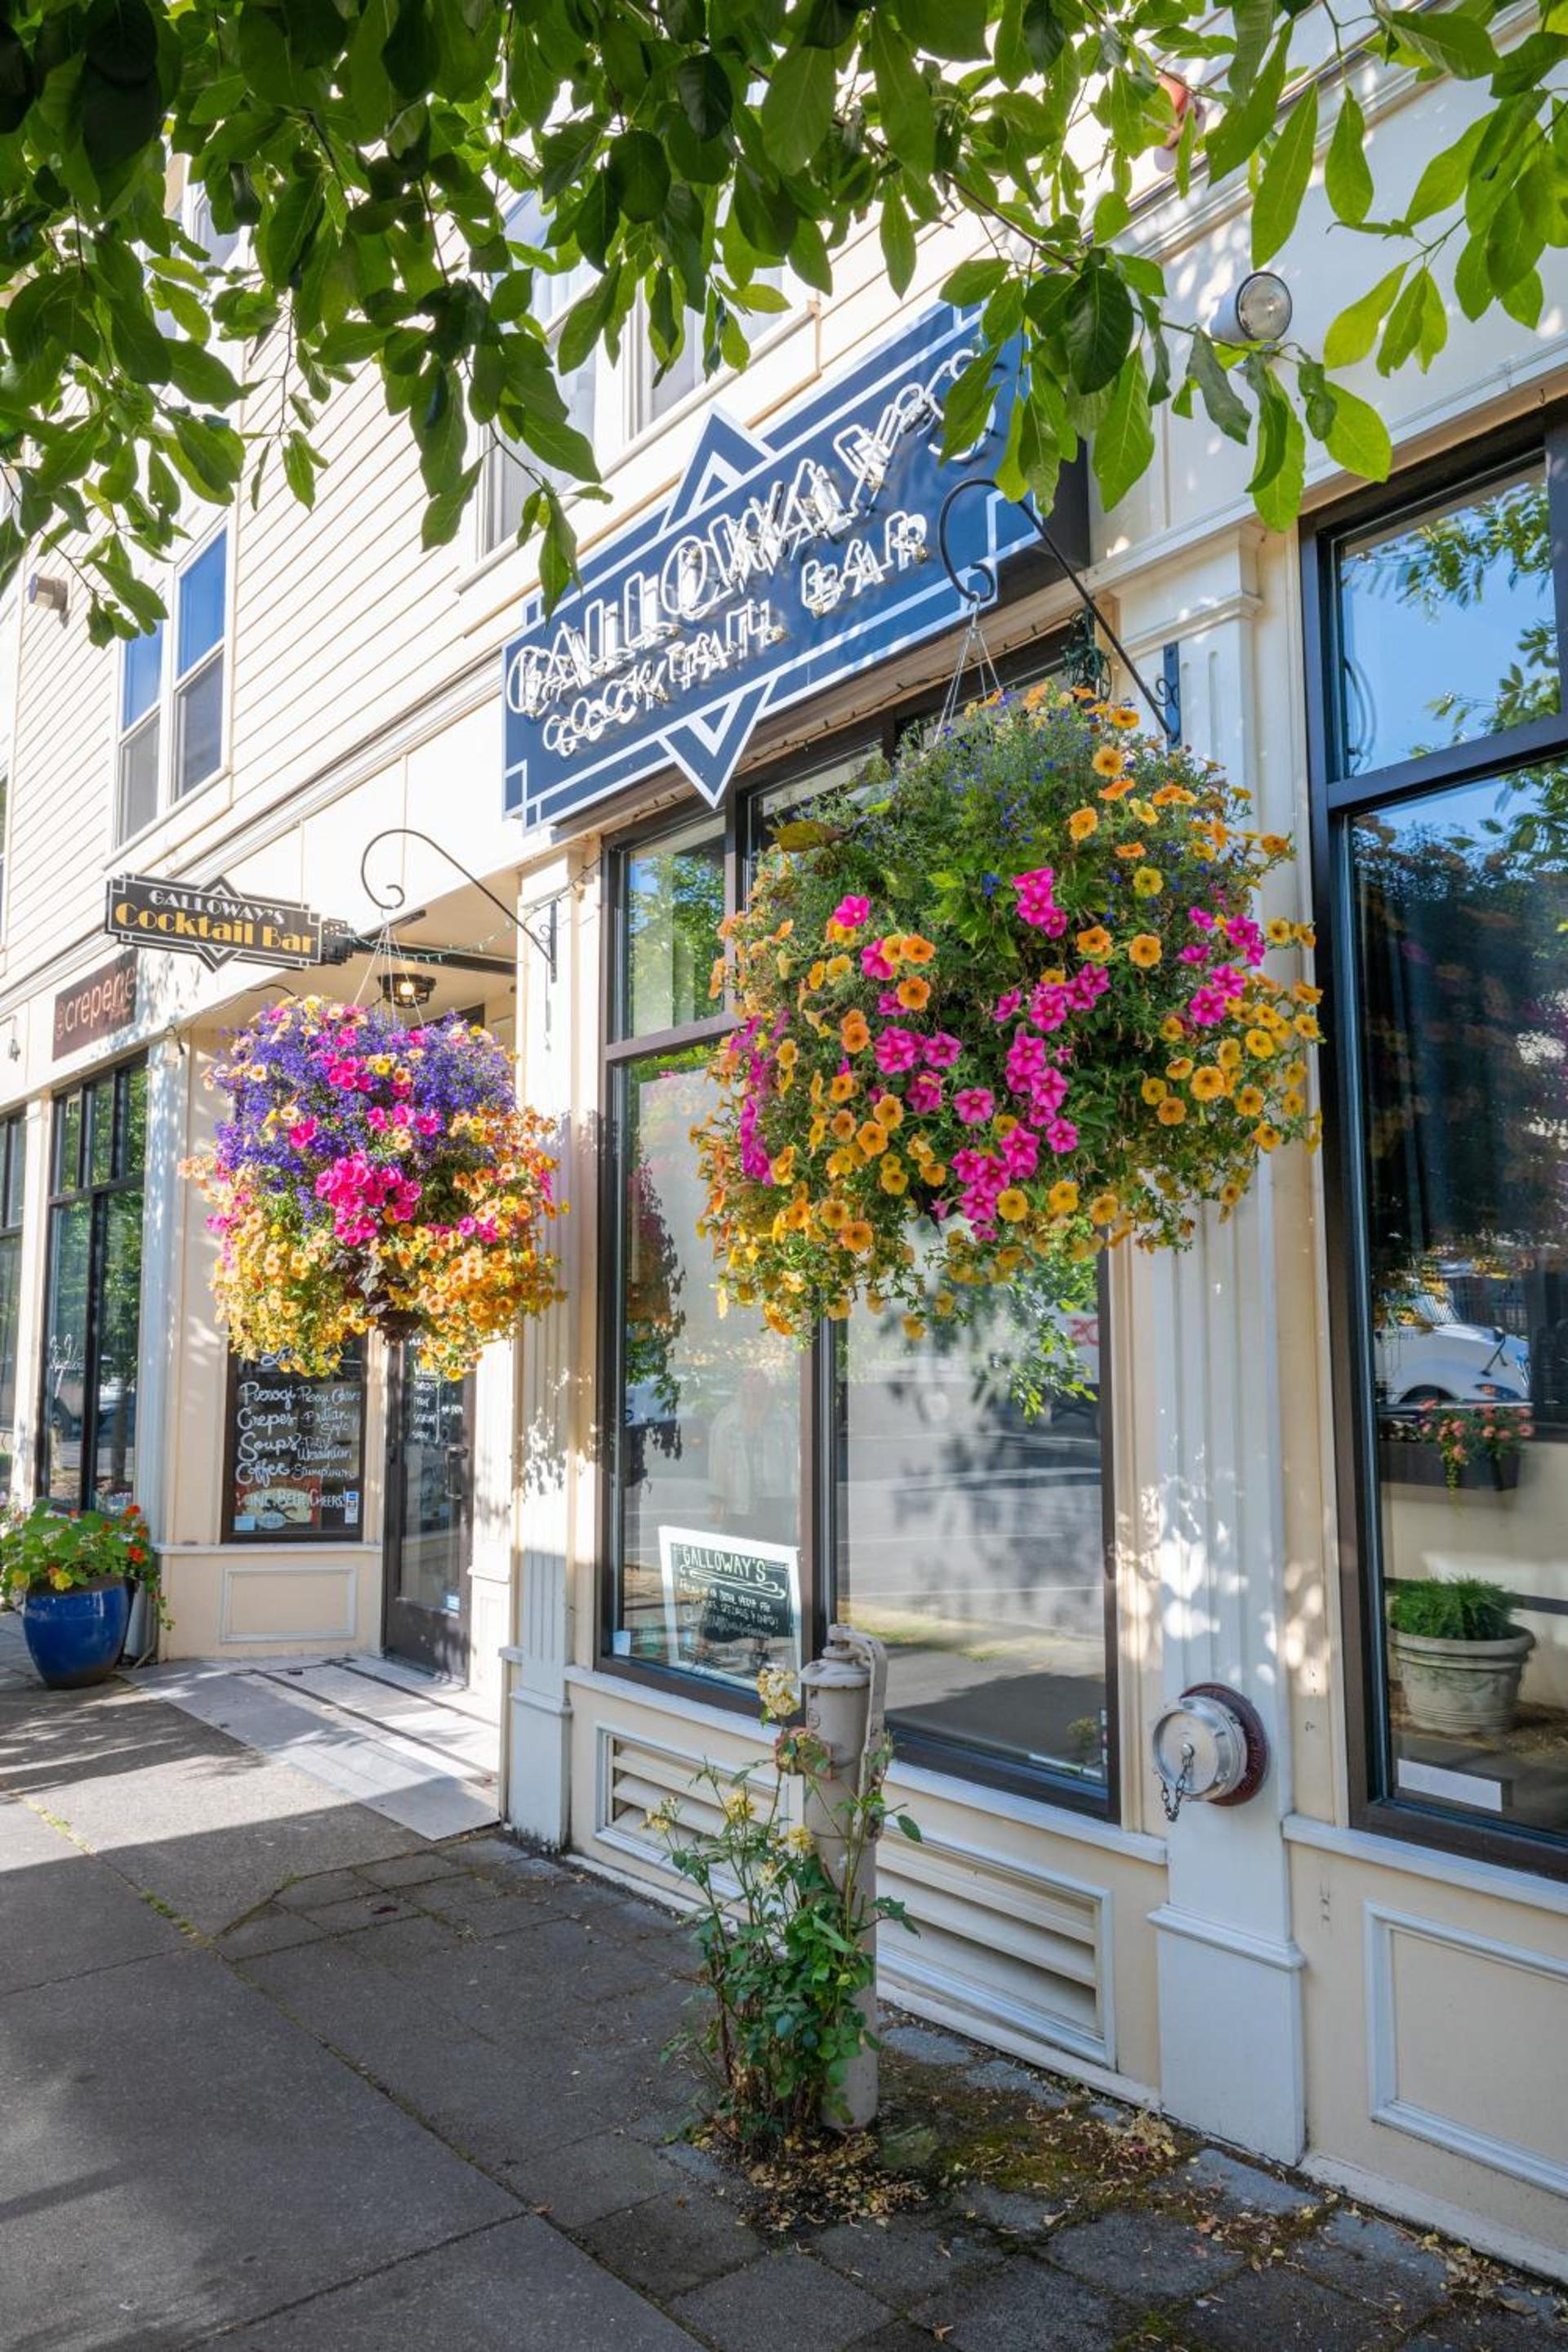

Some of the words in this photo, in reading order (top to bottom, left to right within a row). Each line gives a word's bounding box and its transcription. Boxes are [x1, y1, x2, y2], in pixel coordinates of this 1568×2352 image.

[542, 599, 786, 757] COCKTAIL
[802, 510, 929, 619] BAR
[149, 889, 286, 925] GALLOWAY'S
[114, 902, 254, 946] Cocktail
[262, 925, 316, 956] Bar
[235, 1458, 289, 1488] Coffee
[682, 1545, 767, 1583] GALLOWAY'S
